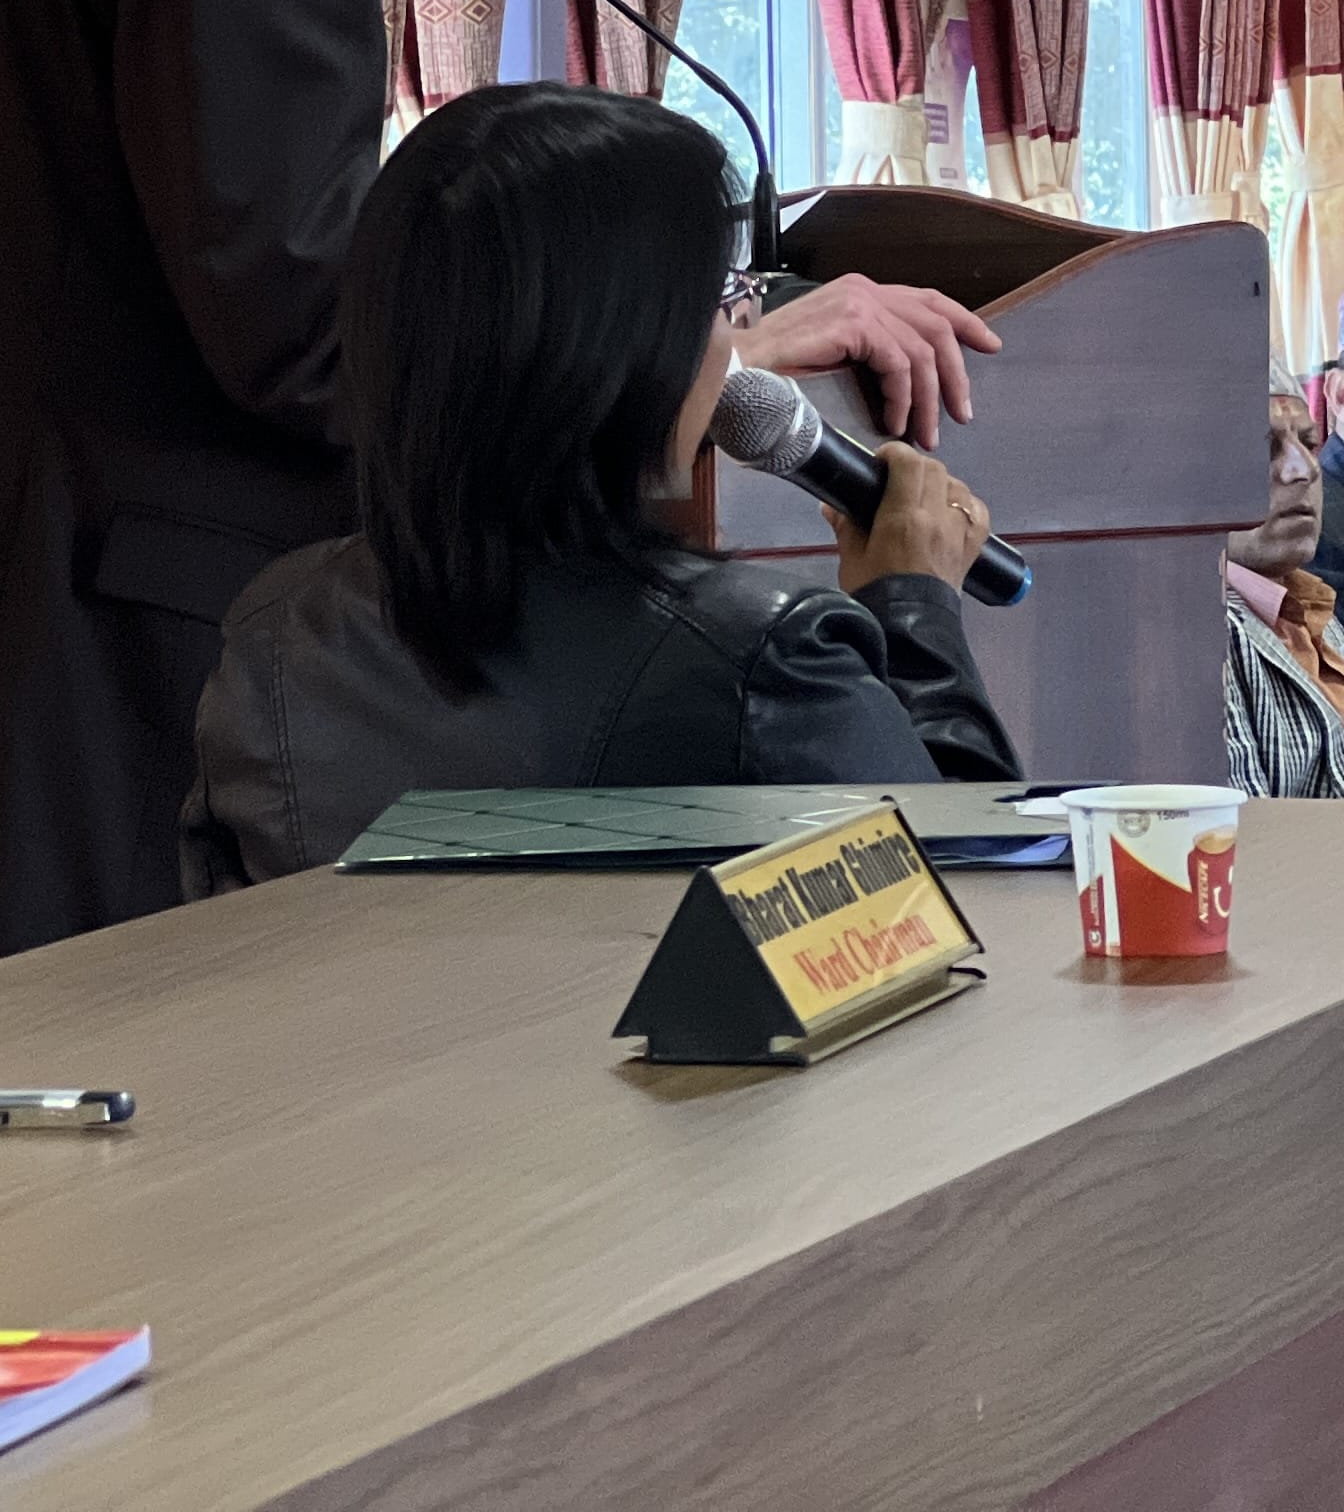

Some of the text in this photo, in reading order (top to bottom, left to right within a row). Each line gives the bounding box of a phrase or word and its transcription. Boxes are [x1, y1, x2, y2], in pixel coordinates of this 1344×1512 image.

[726, 829, 921, 947] Bharat Kumar Ghimire
[793, 918, 938, 996] Ward Chairman
